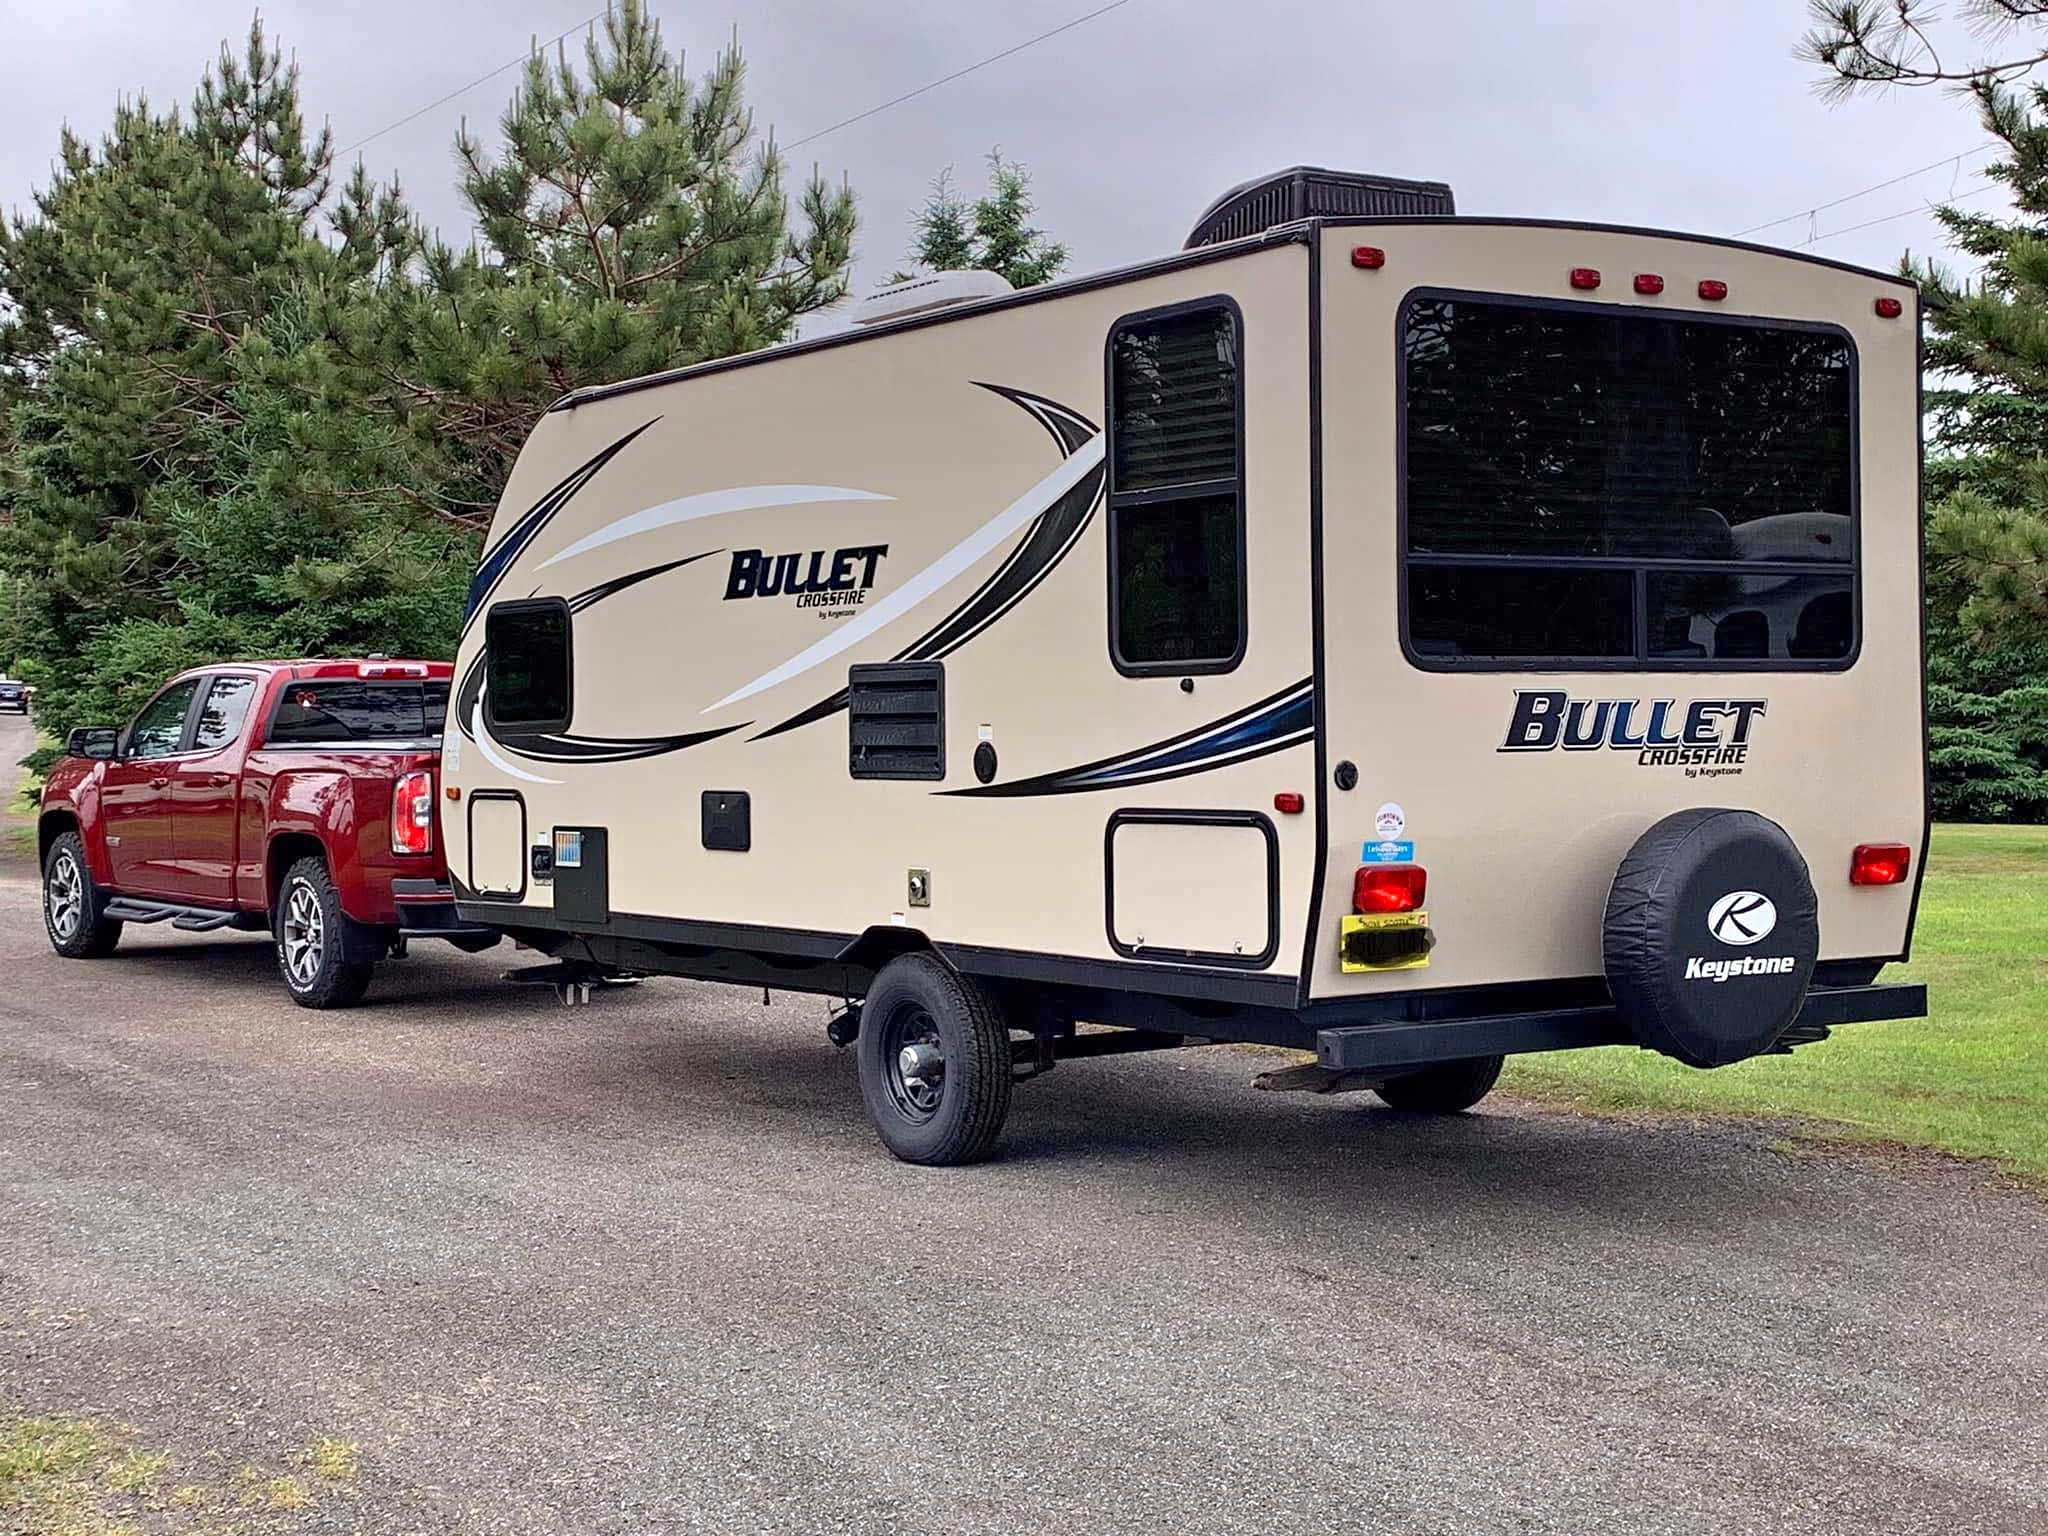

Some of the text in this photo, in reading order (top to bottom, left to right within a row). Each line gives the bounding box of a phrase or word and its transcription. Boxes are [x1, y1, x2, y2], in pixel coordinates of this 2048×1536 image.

[723, 544, 889, 601] BULLET
[796, 589, 866, 608] CROSSFIRE
[1496, 688, 1768, 752] BULLET
[1638, 748, 1748, 766] CROSSFIRE
[1685, 767, 1743, 778] by Keystone
[1684, 956, 1795, 983] Keystone
